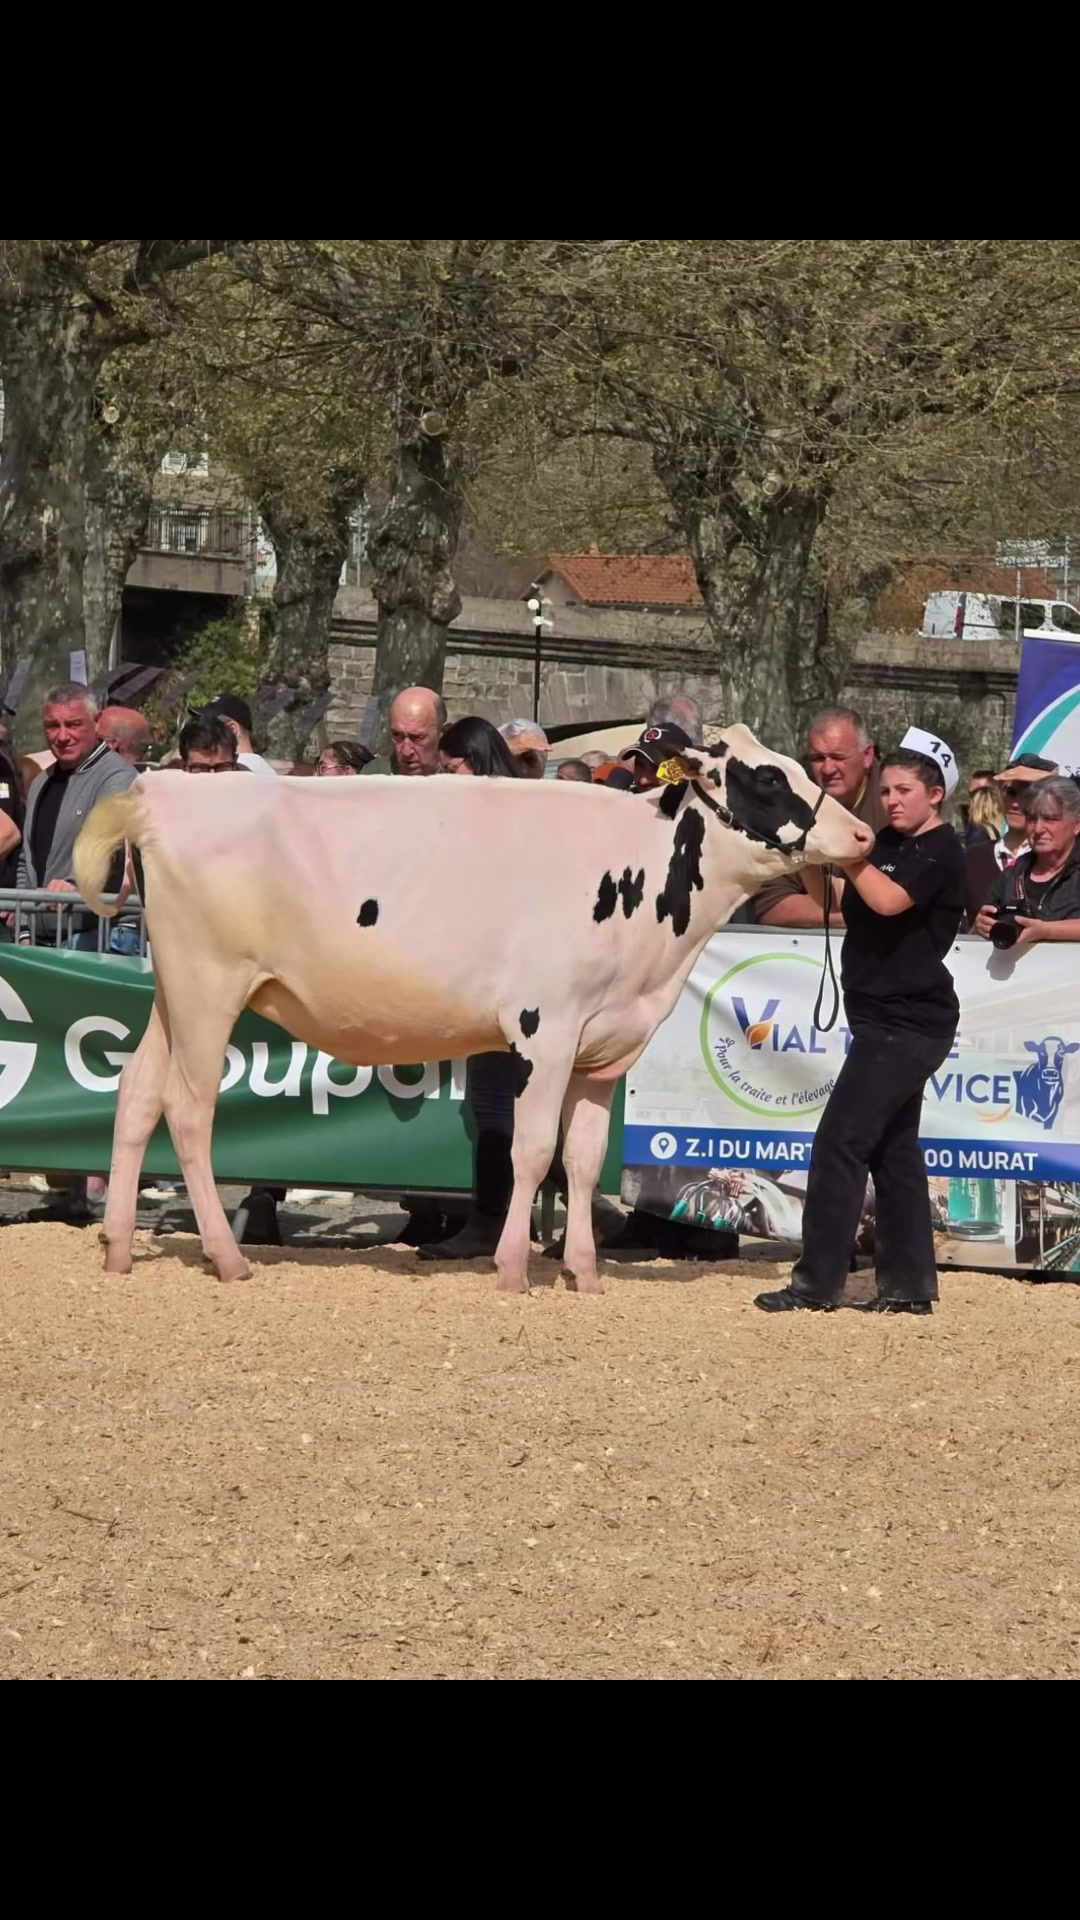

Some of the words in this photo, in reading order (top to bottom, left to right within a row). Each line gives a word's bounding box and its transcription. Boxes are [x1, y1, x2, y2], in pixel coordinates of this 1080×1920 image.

[930, 741, 952, 768] 14
[731, 996, 826, 1054] VIAL
[728, 1070, 741, 1084] la
[740, 1081, 772, 1103] traite
[775, 1095, 787, 1106] et
[923, 1073, 1011, 1105] VICE
[685, 1138, 713, 1158] Z.I
[719, 1139, 750, 1159] DU
[924, 1148, 952, 1168] 00
[958, 1150, 1039, 1171] MURAT
